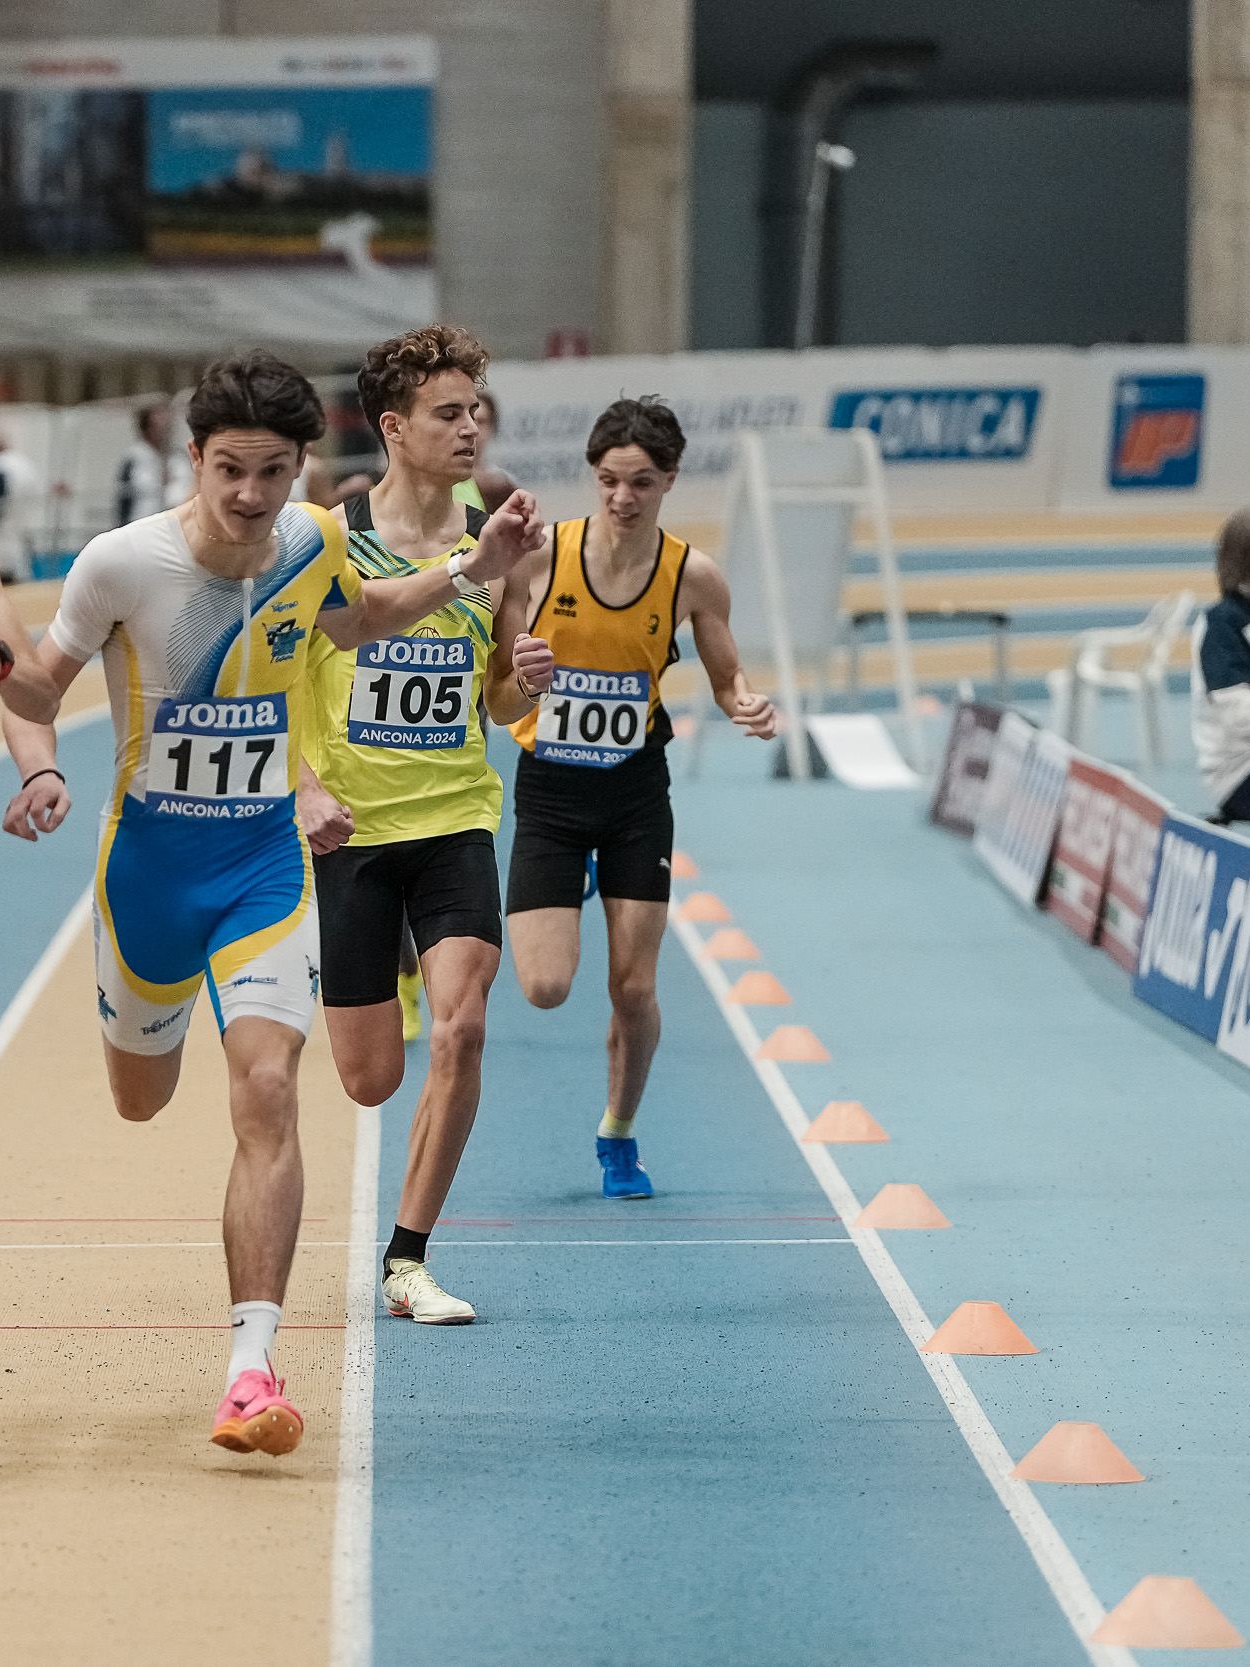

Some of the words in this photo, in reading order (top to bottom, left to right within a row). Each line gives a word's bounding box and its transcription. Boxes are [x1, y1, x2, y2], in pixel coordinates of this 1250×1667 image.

[852, 393, 1026, 455] CONICA
[369, 672, 464, 725] 105
[359, 728, 422, 745] ANCONA
[425, 731, 457, 745] 2024
[552, 699, 638, 746] 100
[167, 737, 276, 795] 117
[543, 746, 601, 762] ANCONA
[602, 751, 627, 763] 202
[157, 799, 231, 818] ANCONA
